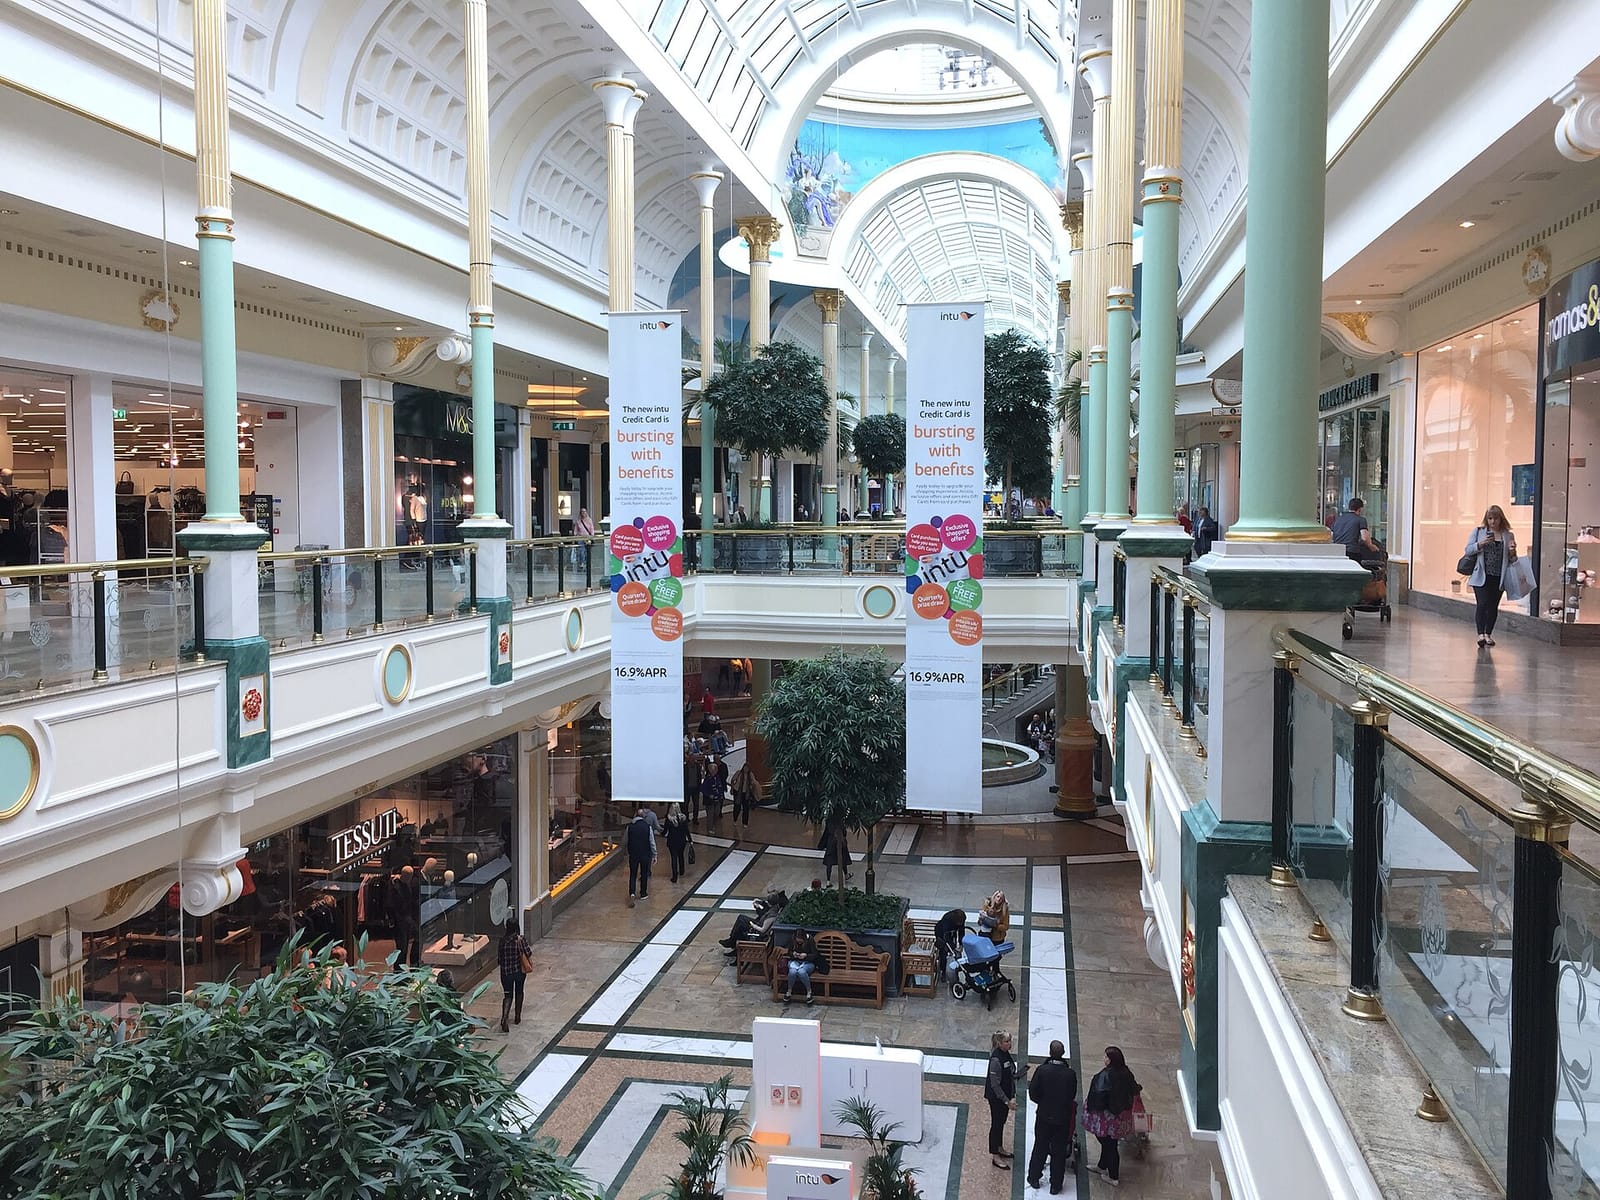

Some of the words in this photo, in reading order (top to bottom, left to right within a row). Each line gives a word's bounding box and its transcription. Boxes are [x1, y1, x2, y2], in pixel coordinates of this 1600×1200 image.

[940, 312, 958, 320] intu
[640, 322, 657, 330] intu
[622, 416, 644, 424] Credit
[920, 410, 943, 418] Credit
[617, 430, 674, 445] bursting
[914, 425, 976, 441] bursting
[631, 448, 661, 460] with
[929, 444, 960, 457] with
[618, 466, 674, 479] benefits
[914, 462, 974, 476] benefits
[625, 550, 669, 582] intu
[921, 551, 968, 584] intu
[917, 594, 943, 603] Quarterly
[614, 667, 668, 678] 16.9%APR
[910, 672, 965, 684] 16.9%APR
[795, 1171, 820, 1184] intu
